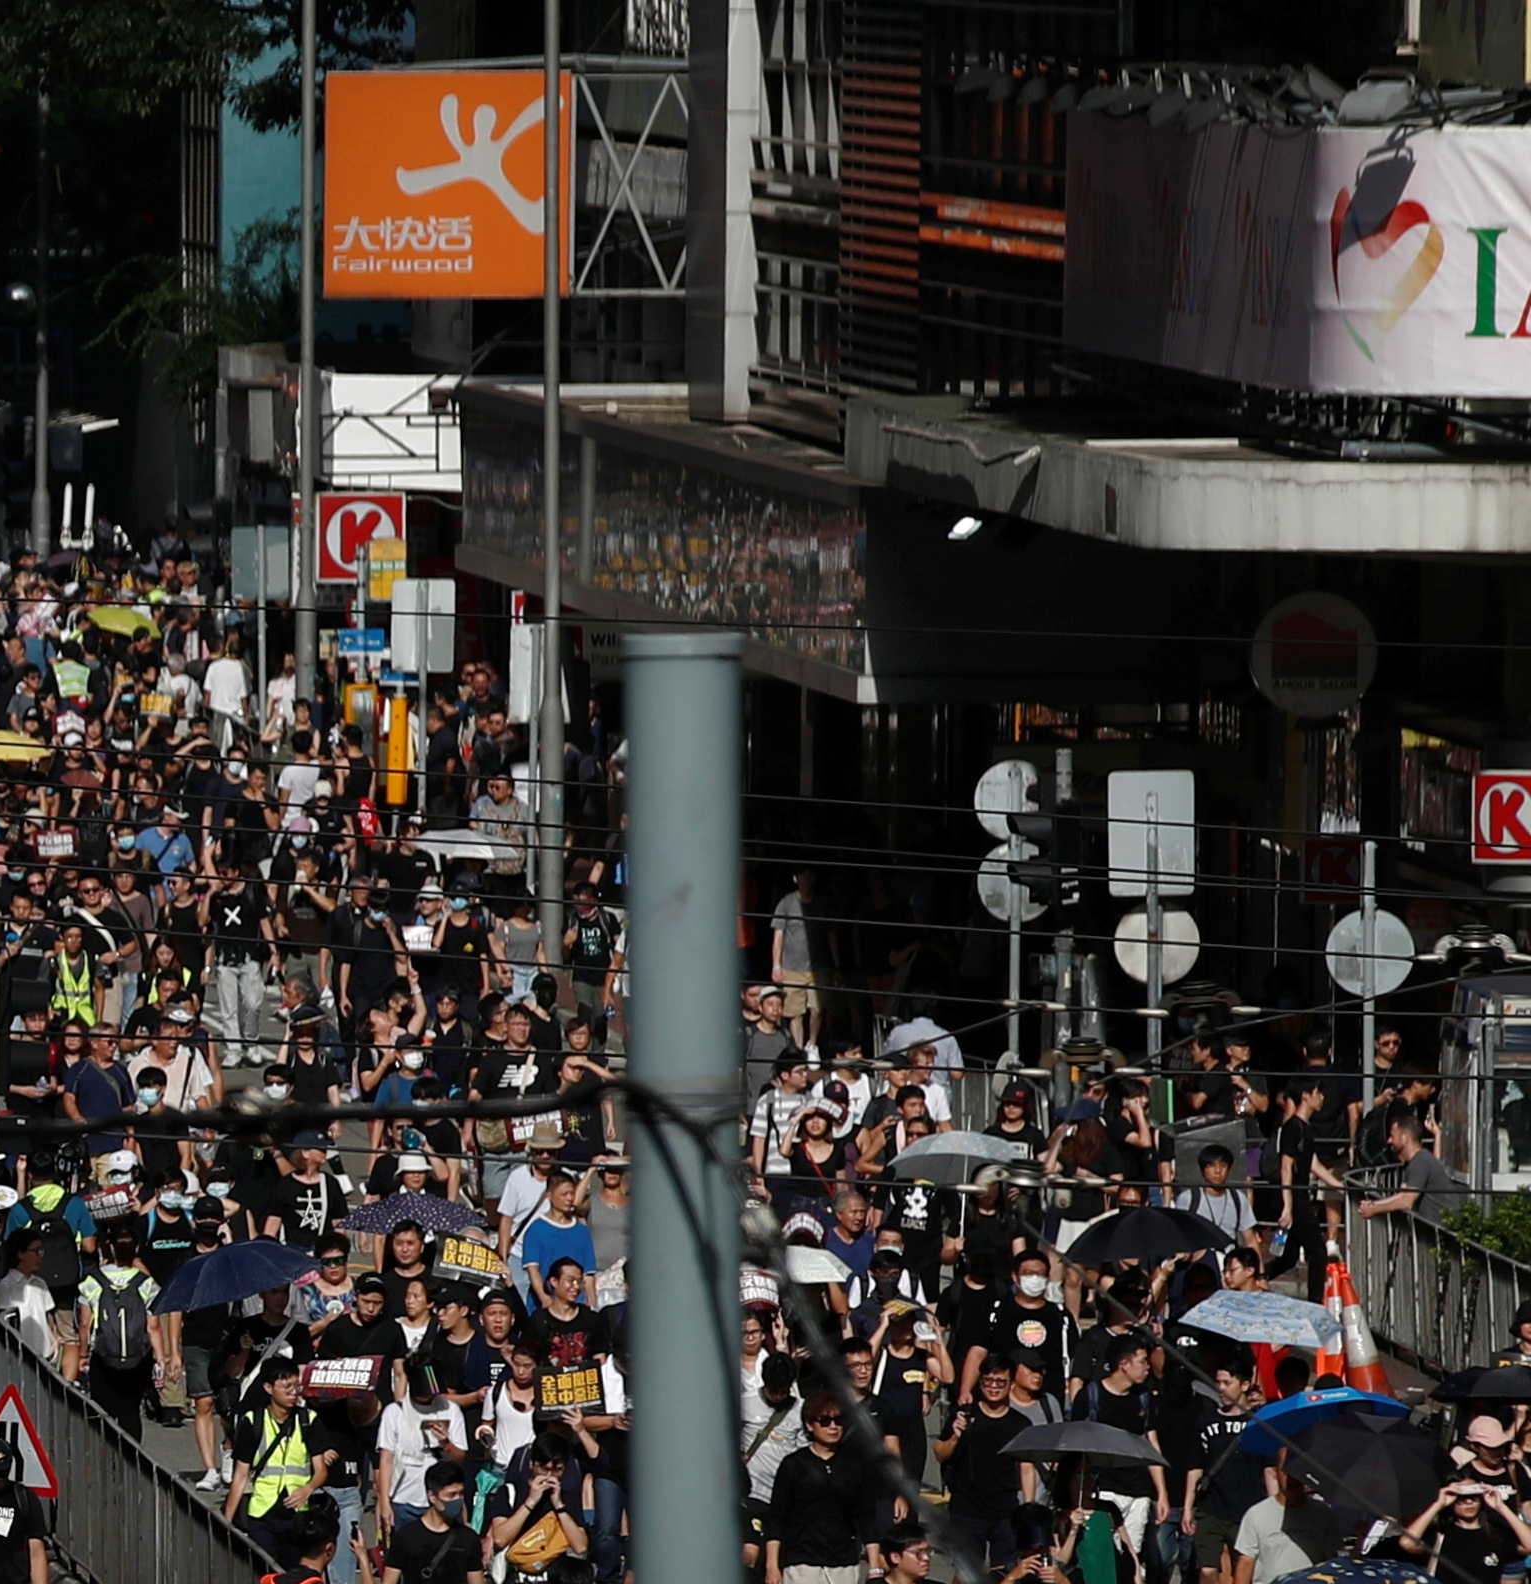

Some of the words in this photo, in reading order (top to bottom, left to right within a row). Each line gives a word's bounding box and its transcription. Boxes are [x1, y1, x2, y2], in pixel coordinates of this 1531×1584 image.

[333, 215, 472, 251] 大快活
[333, 255, 472, 273] Fairwood
[340, 510, 382, 563] K
[1272, 678, 1315, 690] AMOUR
[1318, 678, 1358, 690] SALON
[1488, 790, 1531, 851] K
[1319, 852, 1356, 889] K
